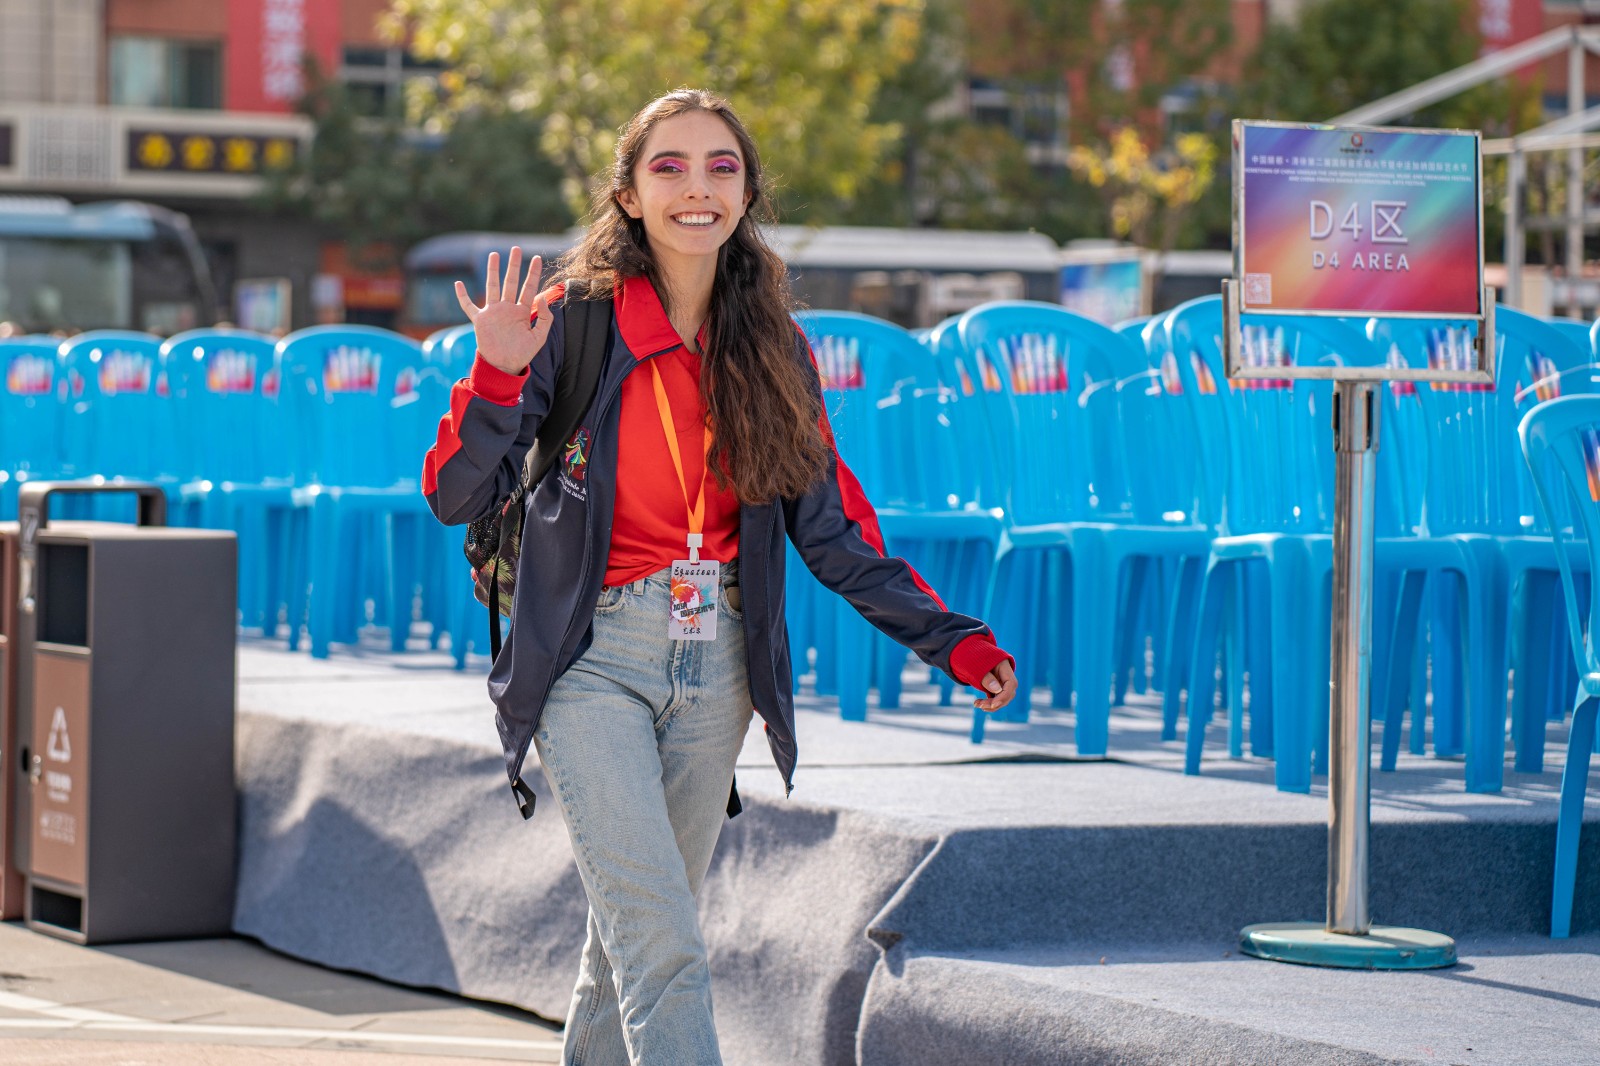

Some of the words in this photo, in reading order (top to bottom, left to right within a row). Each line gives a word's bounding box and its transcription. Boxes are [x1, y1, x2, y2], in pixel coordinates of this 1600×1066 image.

[1310, 200, 1408, 244] D4区
[1313, 250, 1339, 269] D4
[1352, 252, 1410, 272] AREA
